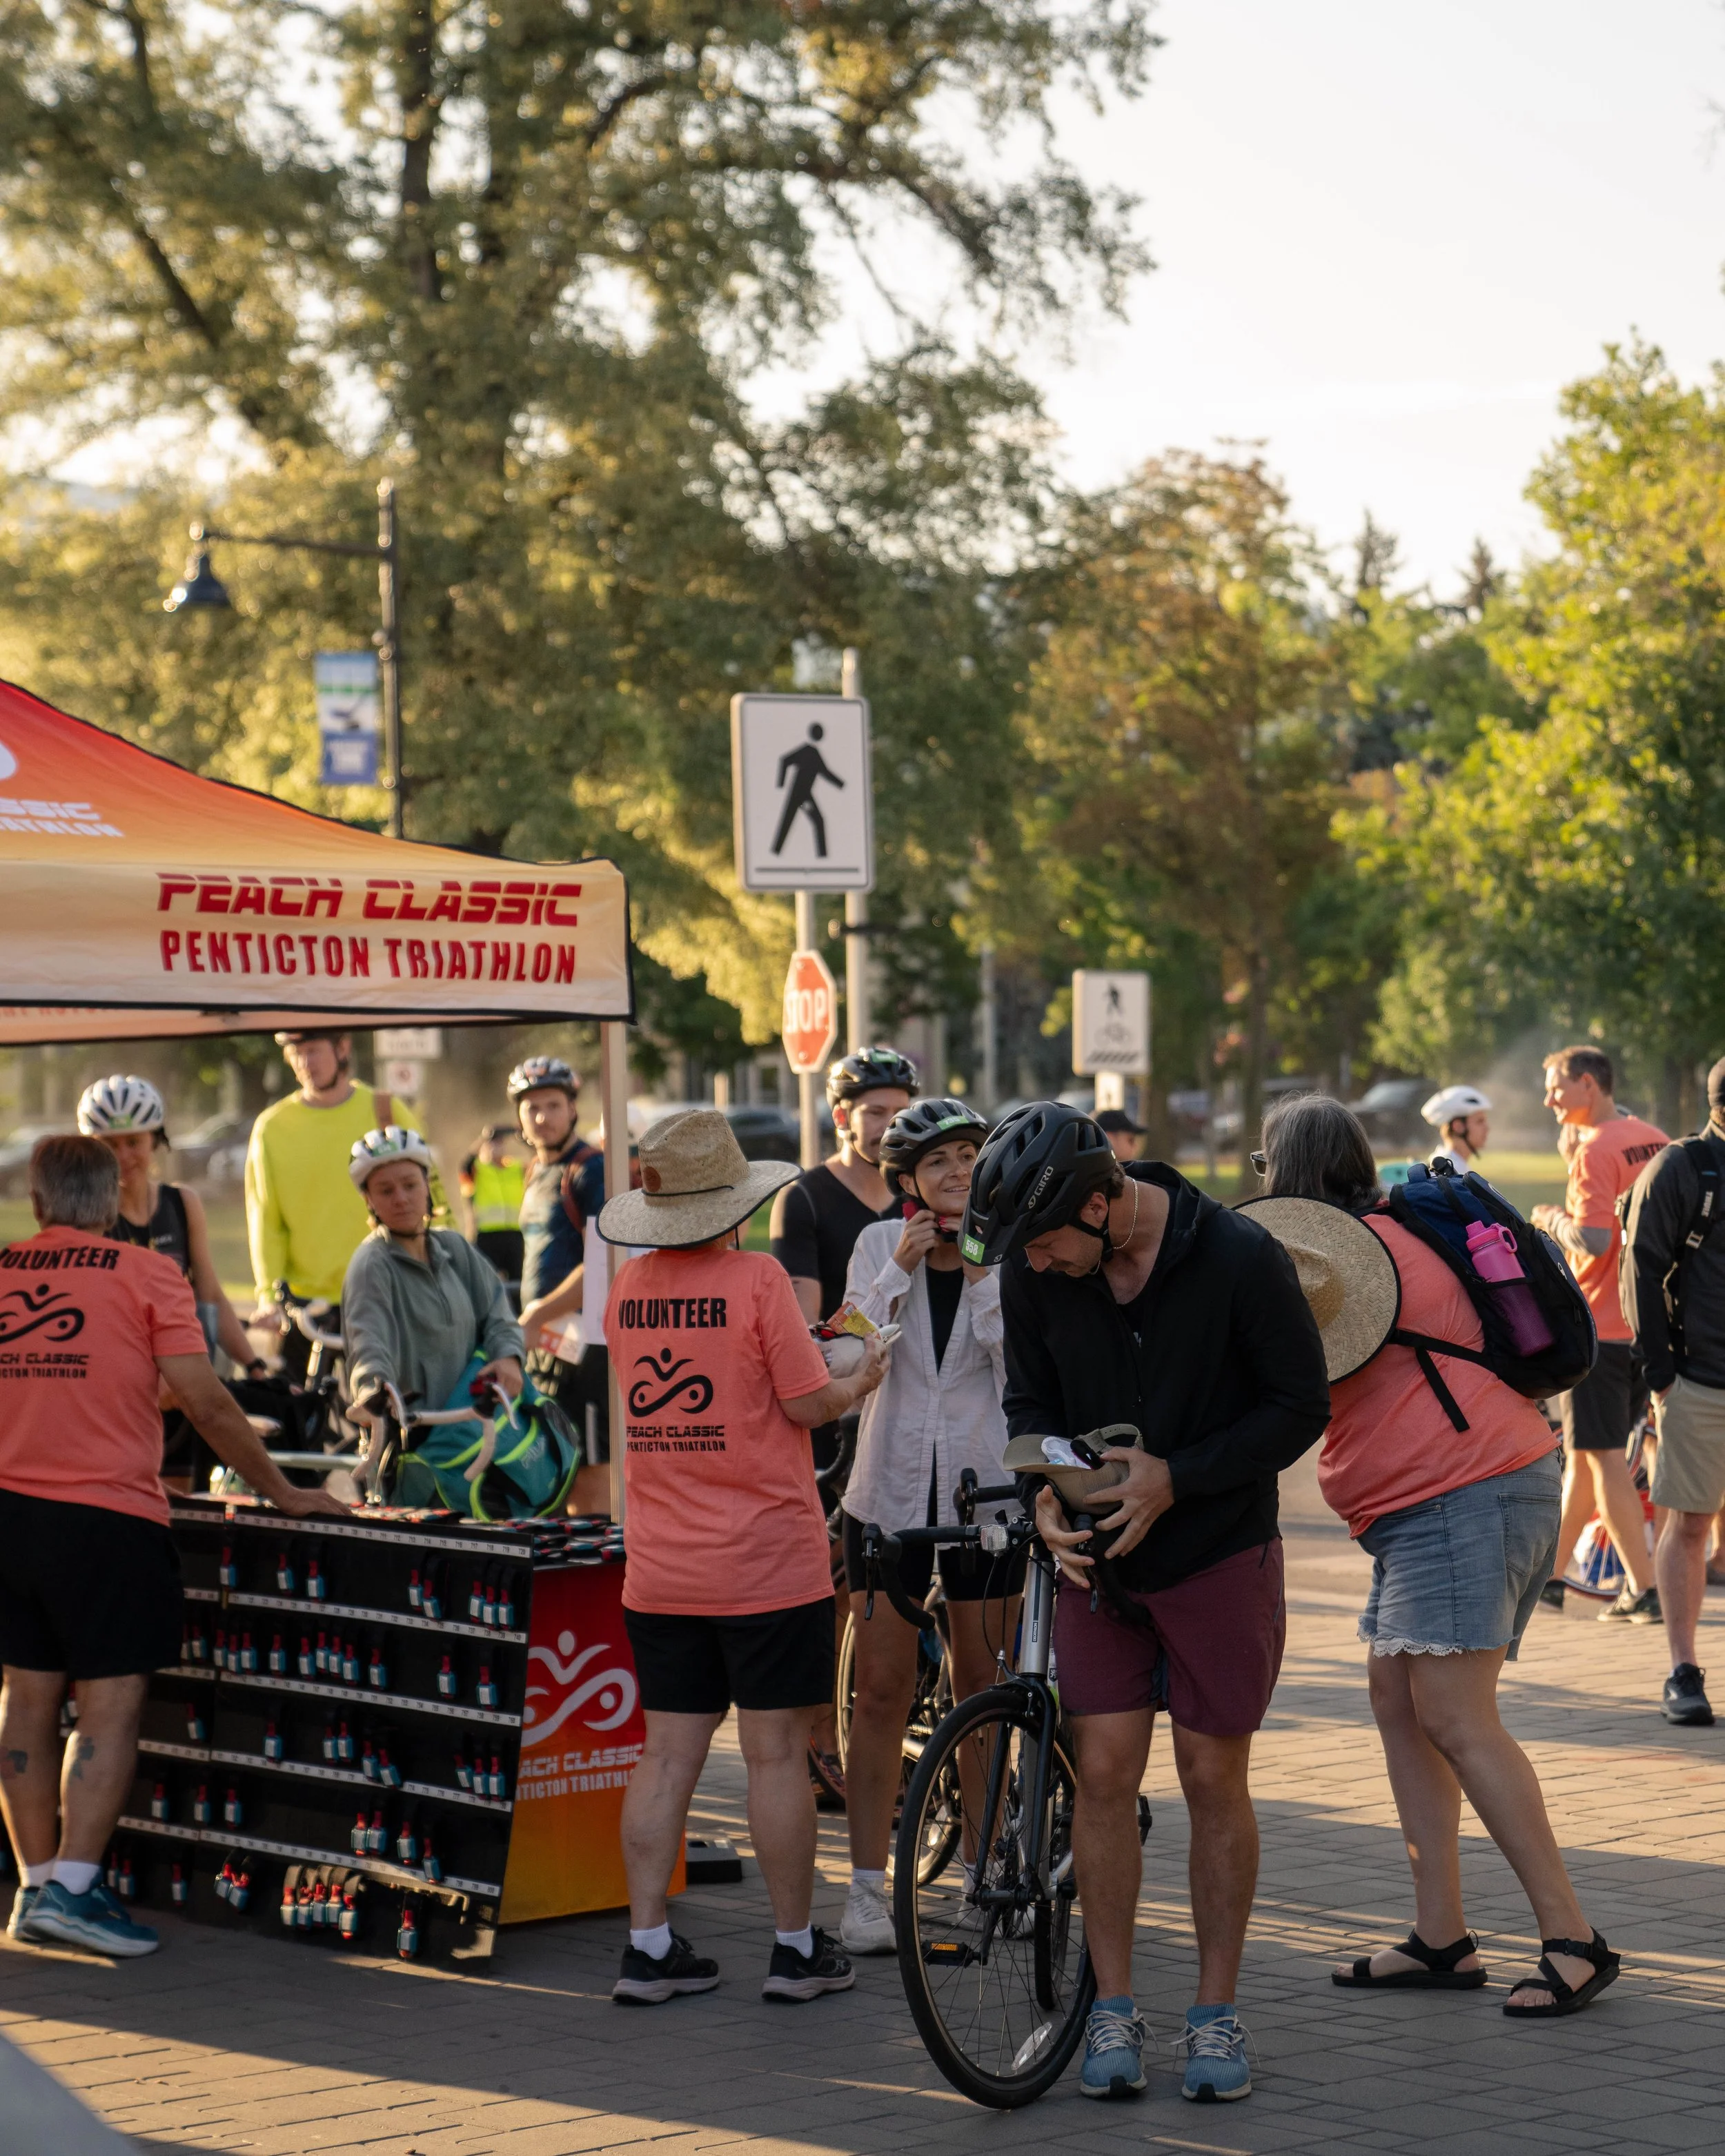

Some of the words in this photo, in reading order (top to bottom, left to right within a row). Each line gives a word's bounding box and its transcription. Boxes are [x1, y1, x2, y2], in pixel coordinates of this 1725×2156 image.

[0, 798, 100, 820] SSIC
[0, 817, 125, 838] ATHLON
[156, 872, 343, 918] PEACH
[362, 878, 582, 927] CLASSIC
[160, 929, 370, 978] PENTICTON
[383, 938, 577, 985] TRIATHLON
[786, 988, 826, 1033] STOP
[1621, 1143, 1668, 1166] VOLUNT
[1034, 1166, 1054, 1196] GIRO
[966, 1240, 978, 1256] 558
[618, 1298, 727, 1329] VOLUNTEER
[26, 1353, 89, 1365] CLASSIC
[32, 1368, 86, 1378] TRIATHLON
[626, 1425, 662, 1438] PEACH
[666, 1425, 724, 1438] CLASSIC
[627, 1441, 670, 1452] PENTICTON
[672, 1441, 727, 1452] TRIATHLON
[519, 1755, 559, 1779] ACH
[563, 1743, 643, 1772] CLASSIC
[516, 1777, 568, 1801] TICTON
[570, 1769, 633, 1792] TRIATHL
